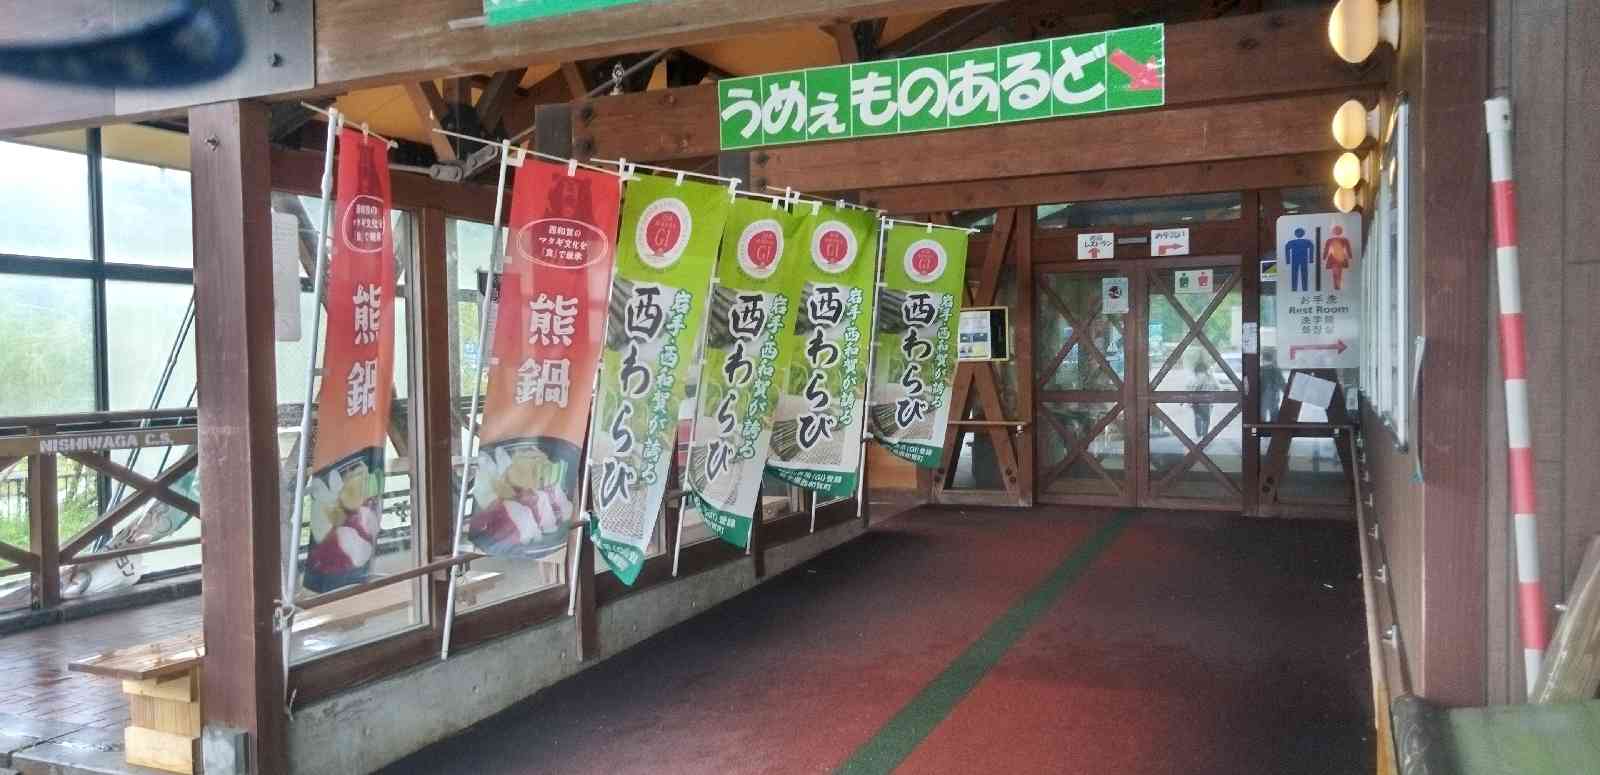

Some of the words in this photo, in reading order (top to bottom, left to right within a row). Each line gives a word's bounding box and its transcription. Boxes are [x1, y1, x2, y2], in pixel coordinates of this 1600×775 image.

[720, 42, 1107, 139] うめぇものあるど
[515, 293, 578, 408] 熊鍋
[798, 286, 844, 449] 西わらび
[895, 291, 937, 428] 西わらび
[1289, 306, 1313, 314] Rest
[1316, 305, 1350, 313] Room
[40, 434, 138, 452] NISHIWAGA
[600, 285, 665, 508] 西わらび
[705, 293, 766, 481] 西わらび
